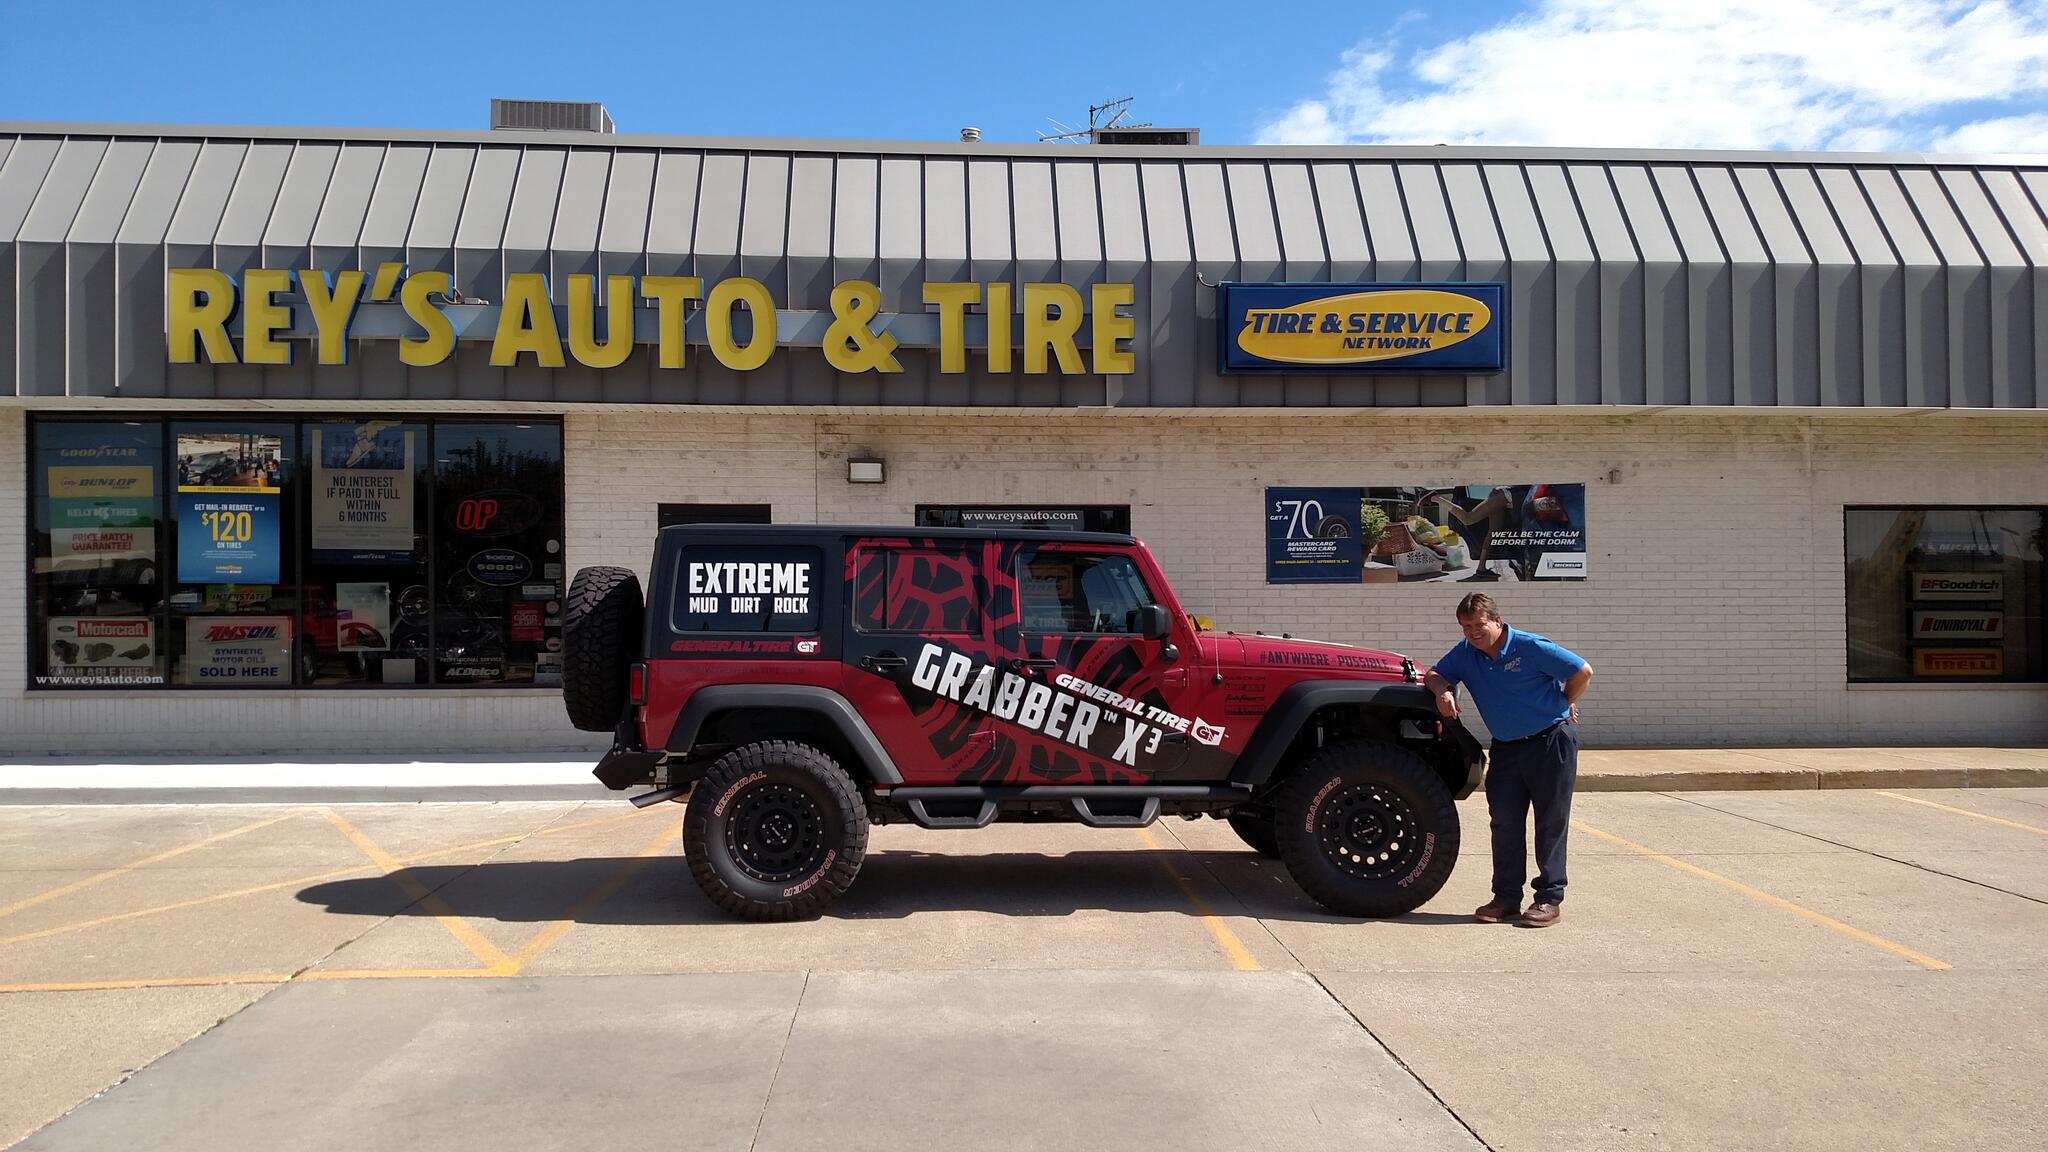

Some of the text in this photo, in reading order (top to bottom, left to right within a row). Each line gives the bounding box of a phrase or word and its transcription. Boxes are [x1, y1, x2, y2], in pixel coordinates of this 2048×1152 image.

[168, 262, 1136, 375] REY'S AUTO & TIRE
[1251, 312, 1474, 334] TIRE & SERVICE
[1342, 337, 1433, 349] NETWORK
[78, 478, 137, 487] DUNLOP
[333, 476, 394, 487] NO INTEREST
[327, 488, 400, 499] IF PAID IN FULL
[194, 503, 205, 511] GET
[346, 500, 381, 510] WITHIN
[339, 511, 387, 522] 6 MONTHS
[962, 511, 1079, 523] www.reysauto.com
[201, 511, 252, 542] $120
[72, 532, 134, 541] PRICE MATCH
[1490, 530, 1518, 538] WE'LL
[1520, 530, 1533, 538] BE
[1553, 530, 1580, 538] CALM
[689, 562, 811, 594] EXTREME
[1919, 579, 1999, 590] BFGoodrich
[689, 597, 809, 614] MUD DIRT ROCK
[79, 622, 145, 636] Motorcraft
[1931, 619, 1985, 632] UNIROYAL
[205, 626, 277, 641] AMSOIL
[215, 648, 263, 656] SYNTHETIC
[212, 656, 244, 664] MOTOR
[1923, 653, 1998, 670] PIRELLI
[199, 667, 279, 677] SOLD HERE
[445, 667, 500, 676] ACDelco
[36, 675, 164, 686] www.reysauto.com
[911, 642, 1101, 750] GRABBER
[1055, 673, 1147, 717] GENERAL
[1146, 705, 1193, 733] TIRE
[714, 770, 768, 817] GENERAL
